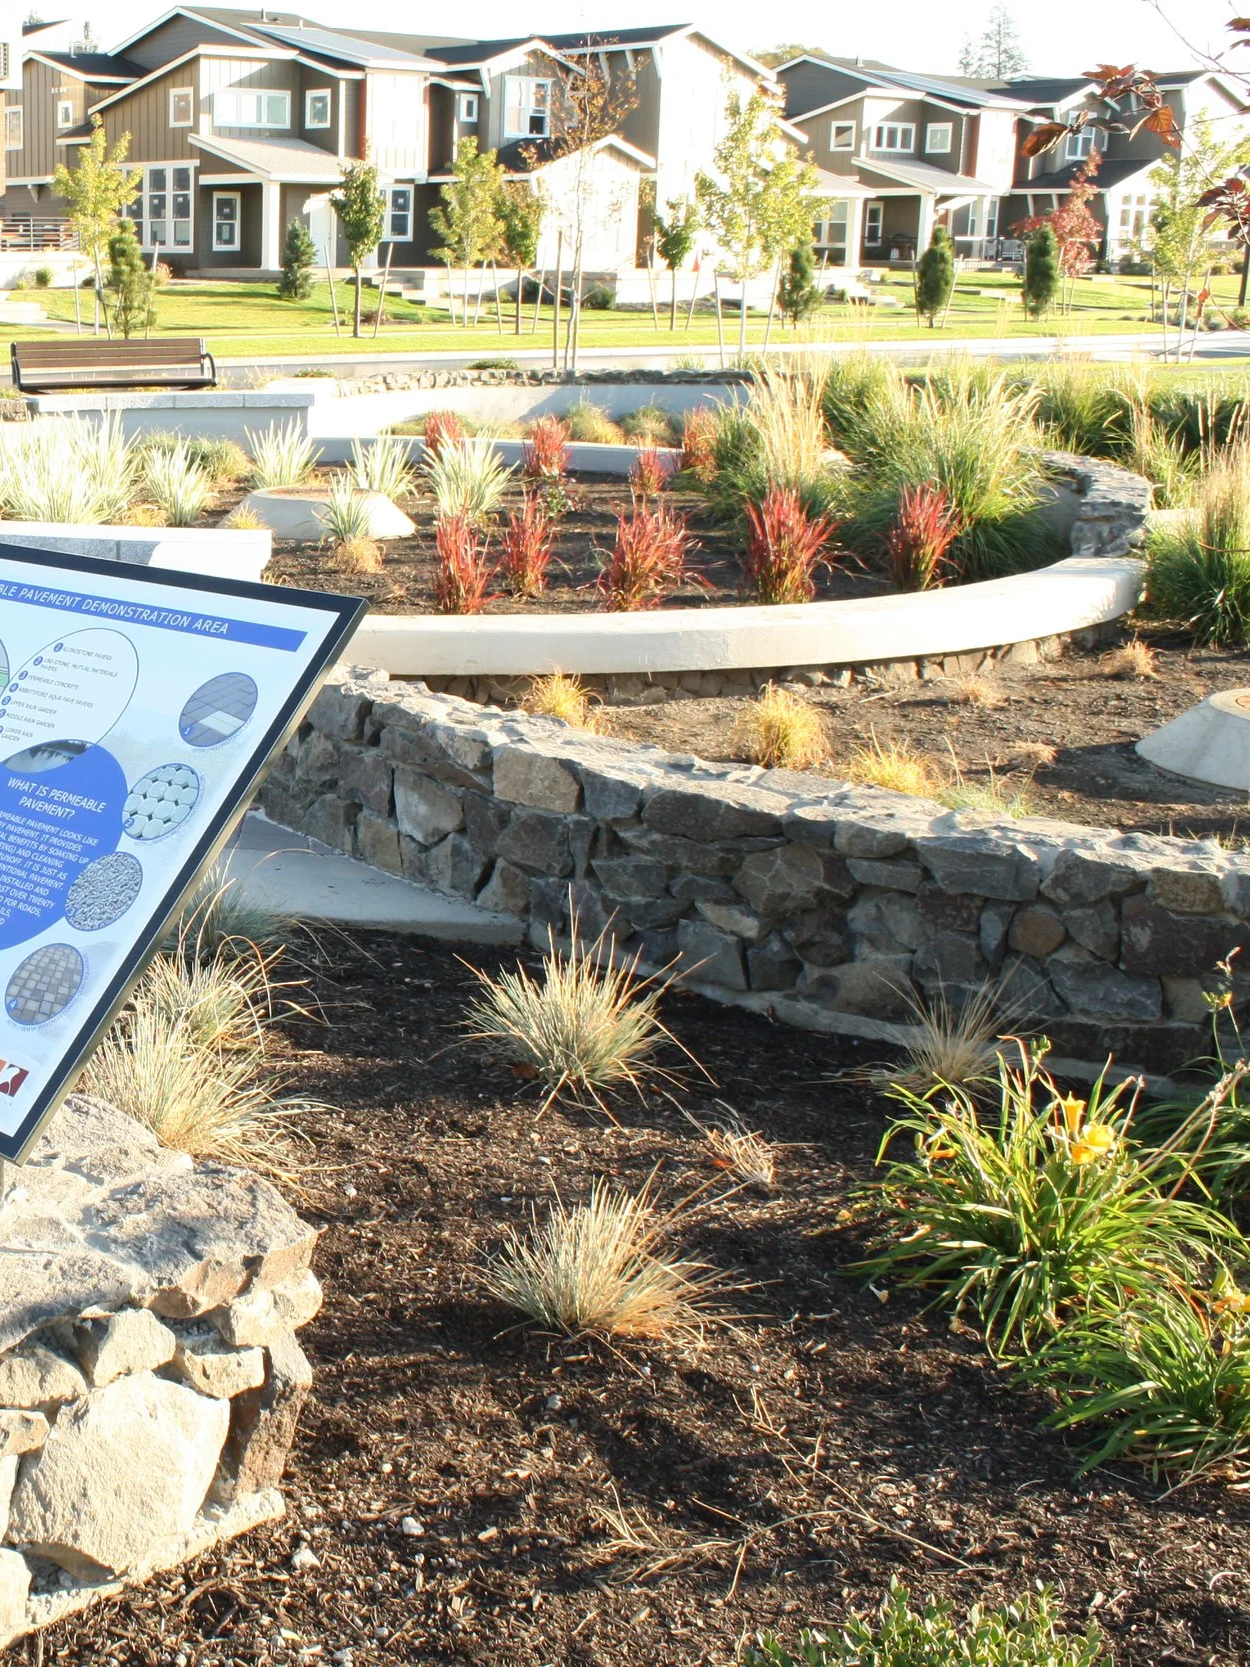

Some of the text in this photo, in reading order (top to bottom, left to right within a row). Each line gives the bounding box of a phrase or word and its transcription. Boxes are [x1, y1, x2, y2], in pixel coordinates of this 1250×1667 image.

[17, 587, 81, 607] PAVEMENT
[80, 598, 191, 627] DEMONSTRATION
[190, 618, 231, 635] AREA
[10, 699, 26, 707] UPPER
[36, 706, 57, 715] GARDEN
[5, 712, 24, 721] MIDDLE
[22, 716, 36, 724] RAIN
[34, 719, 56, 729] GARDEN
[0, 733, 20, 741] GARDEN
[4, 726, 22, 735] LOWER
[5, 777, 107, 813] WHAT IS PERMEABLE
[17, 796, 75, 820] PAVEMENT?
[25, 819, 59, 834] PAVEMENT
[58, 829, 83, 841] LOOKS
[81, 835, 99, 846] LIKE
[6, 834, 39, 850] BENEFITS
[37, 844, 48, 852] BY
[47, 847, 78, 862] SOAKING
[77, 856, 89, 865] UP
[39, 834, 49, 842] IT
[47, 836, 83, 852] PROVIDES
[15, 848, 31, 858] AND
[29, 852, 64, 868] CLEANING
[23, 861, 32, 869] IT
[31, 864, 40, 872] IS
[39, 866, 57, 877] JUST
[55, 871, 68, 880] AS
[27, 873, 65, 891] PAVEMENT.
[32, 886, 49, 896] AND
[2, 897, 18, 908] FOR
[7, 888, 28, 900] OVER
[26, 895, 55, 909] TWENTY
